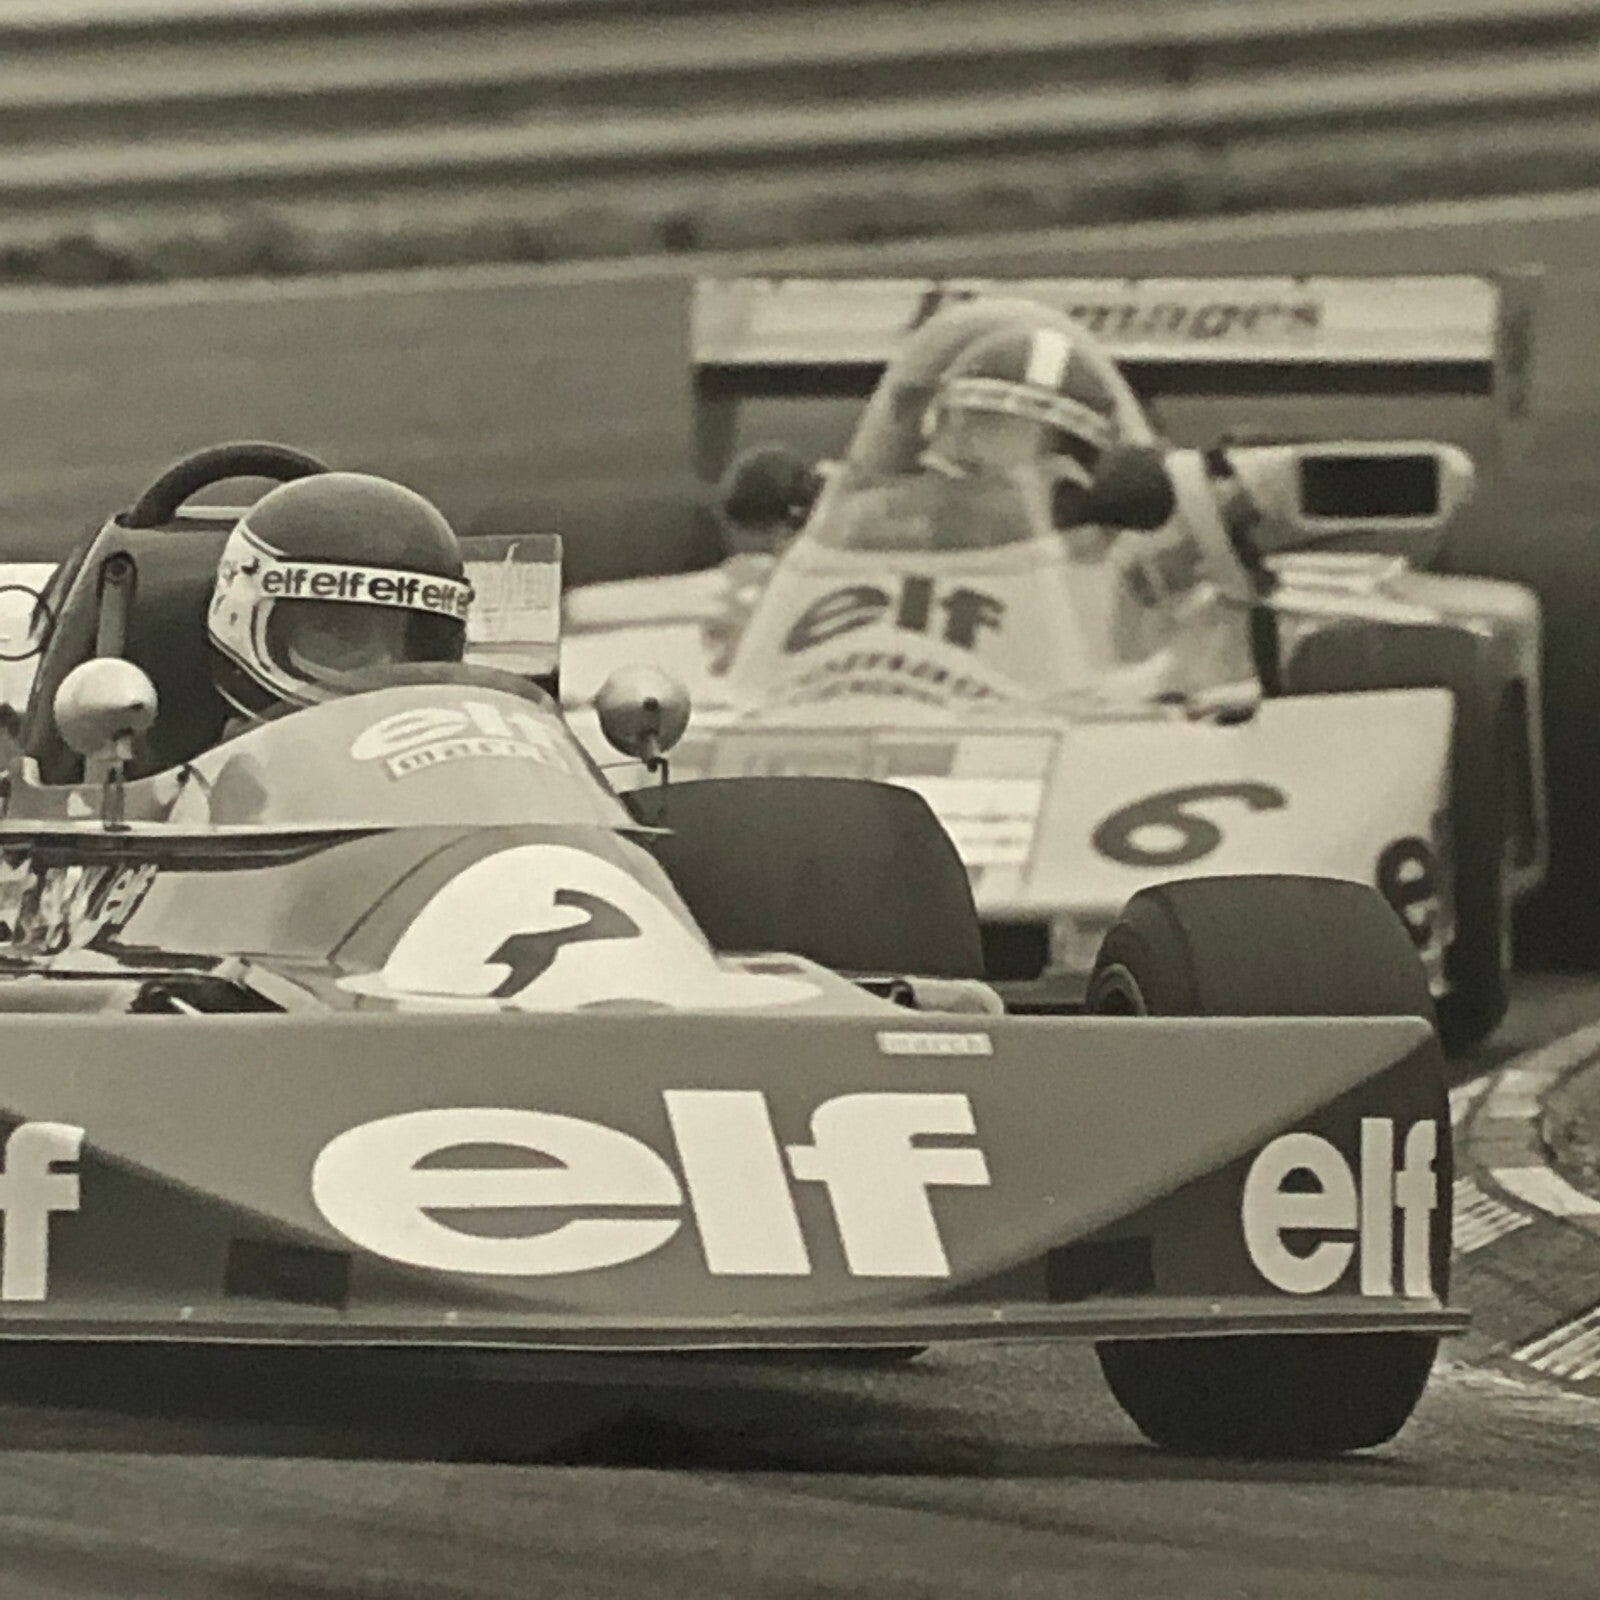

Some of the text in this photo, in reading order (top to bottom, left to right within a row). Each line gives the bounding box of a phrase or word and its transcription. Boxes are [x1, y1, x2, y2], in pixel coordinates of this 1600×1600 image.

[783, 576, 1004, 654] elf
[1093, 782, 1288, 867] 6
[312, 1090, 991, 1278] elf
[1242, 1117, 1438, 1298] elf
